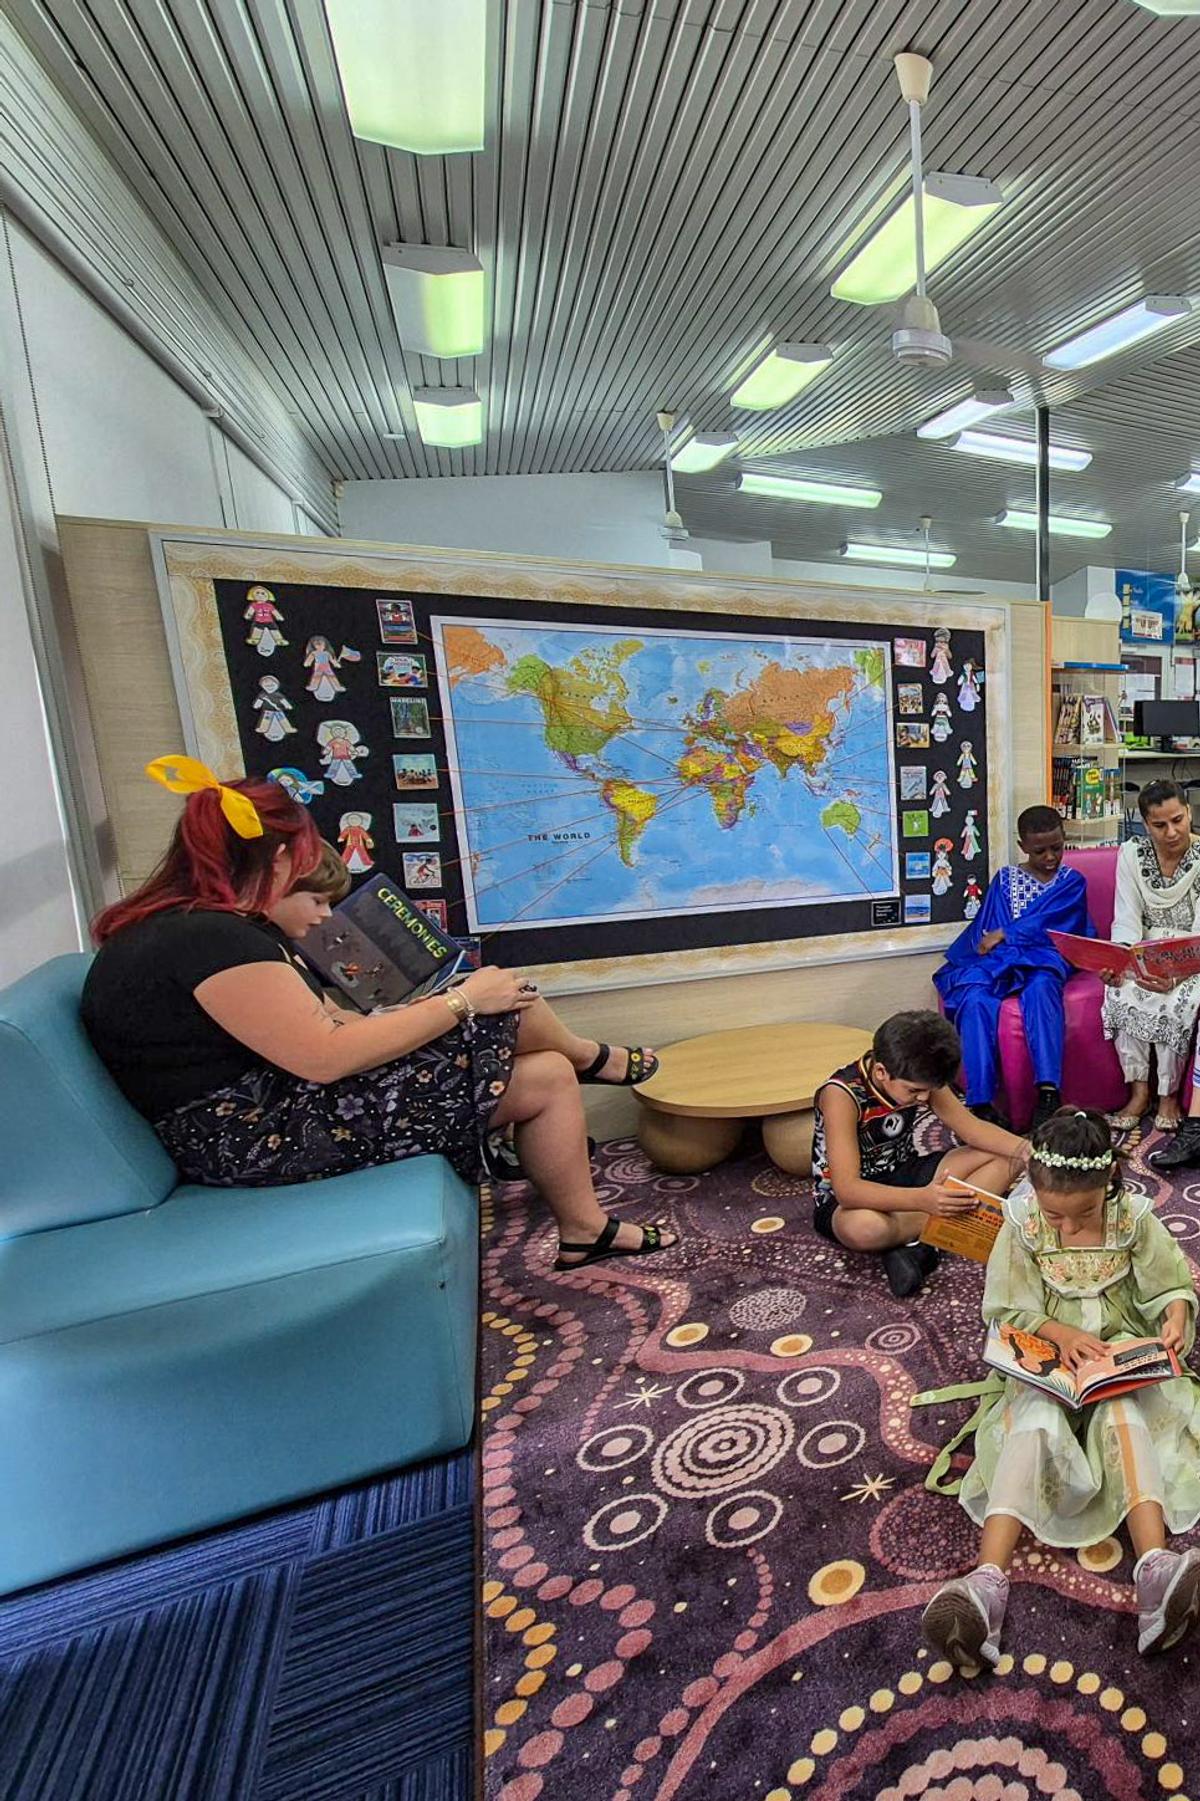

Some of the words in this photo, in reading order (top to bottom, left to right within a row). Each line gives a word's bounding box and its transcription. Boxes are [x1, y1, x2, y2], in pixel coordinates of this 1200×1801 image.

[527, 834, 549, 842] THE
[552, 832, 591, 841] WORLD
[377, 887, 448, 959] CEREMONIES
